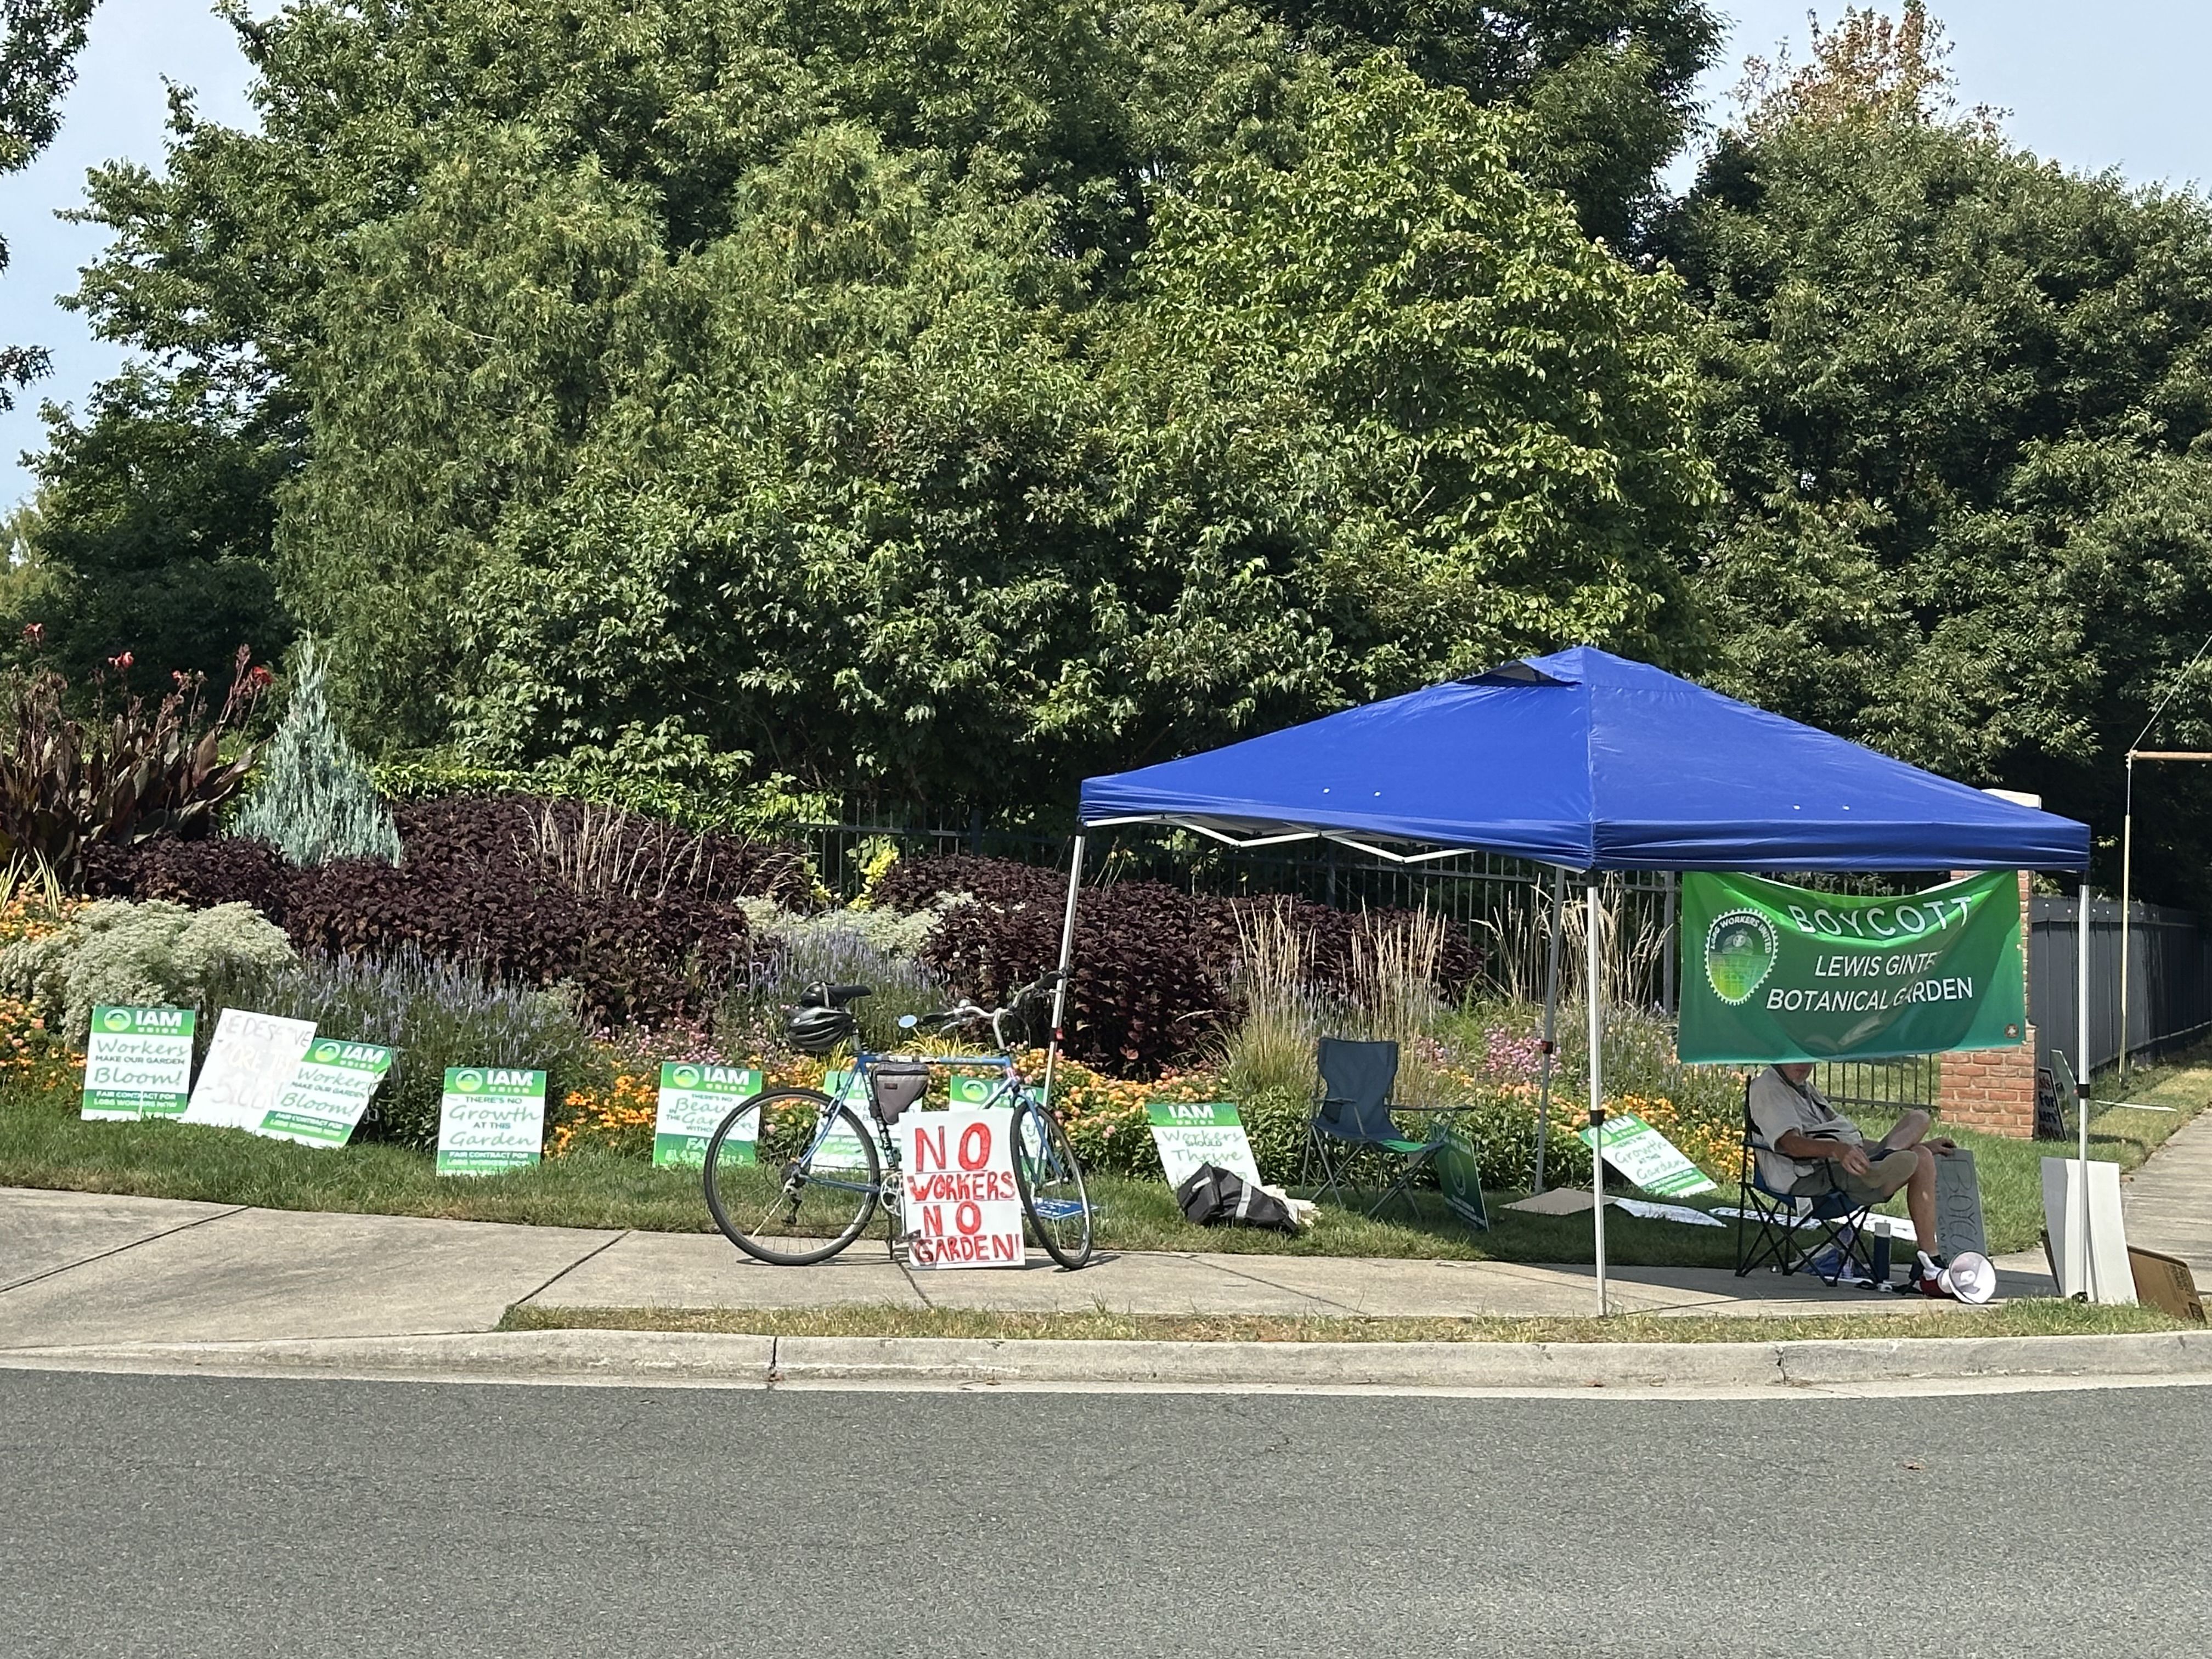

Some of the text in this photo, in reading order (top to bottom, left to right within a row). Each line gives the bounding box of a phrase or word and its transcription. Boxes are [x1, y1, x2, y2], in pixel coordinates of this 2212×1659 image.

[1787, 896, 1972, 937] BOYCOTT
[1719, 915, 1760, 928] WORKERS
[1758, 923, 1773, 953] UNITED
[1814, 950, 1943, 977] LEWIS GINTE
[1766, 977, 1973, 1012] BOTANICAL GARDEN
[136, 1010, 182, 1027] IAM
[243, 1017, 312, 1047] DESEVE
[97, 1038, 188, 1057] Workers
[341, 1045, 386, 1064] IAM
[146, 1057, 185, 1065] GARDEN
[94, 1066, 183, 1086] Bloom!
[487, 1070, 533, 1086] IAM
[703, 1067, 749, 1085] IAM
[291, 1081, 313, 1090] MAKE
[332, 1087, 365, 1099] GARDEN
[280, 1092, 359, 1117] Bloom!
[449, 1104, 541, 1121] Growth
[676, 1098, 736, 1113] Beau
[1168, 1105, 1215, 1119] IAM
[1602, 1115, 1637, 1133] IAM
[449, 1131, 537, 1146] Garden
[686, 1137, 723, 1151] FAI
[1162, 1130, 1242, 1142] Workers
[915, 1122, 991, 1172] NO
[1171, 1148, 1244, 1161] Thrive
[1615, 1139, 1667, 1164] Growth
[1636, 1159, 1685, 1180] Garden
[907, 1171, 1015, 1201] WORKERS
[1940, 1159, 1977, 1255] BOYCO
[923, 1200, 981, 1237] NO
